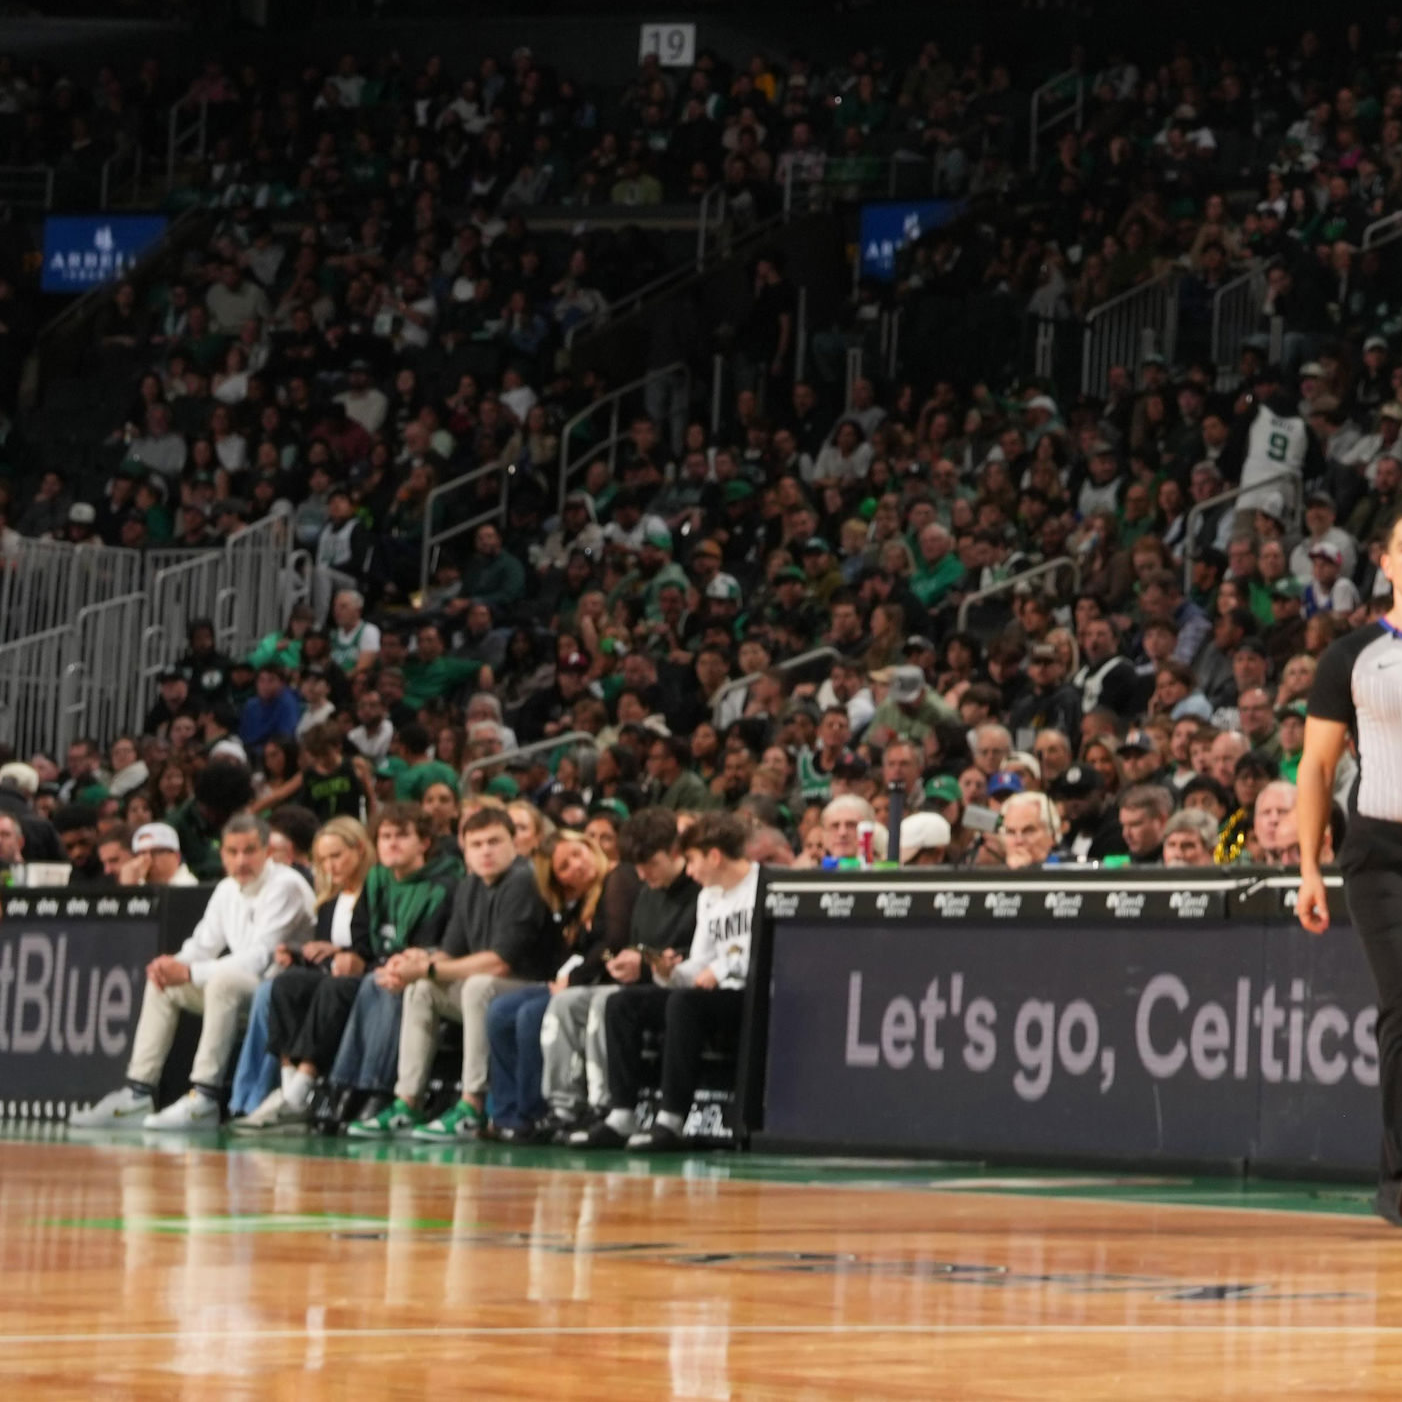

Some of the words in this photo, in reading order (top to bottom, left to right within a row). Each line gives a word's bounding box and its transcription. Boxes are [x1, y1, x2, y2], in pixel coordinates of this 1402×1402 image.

[846, 971, 997, 1072] Let's
[1014, 1009, 1114, 1099] go,
[1135, 974, 1379, 1086] Celtics
